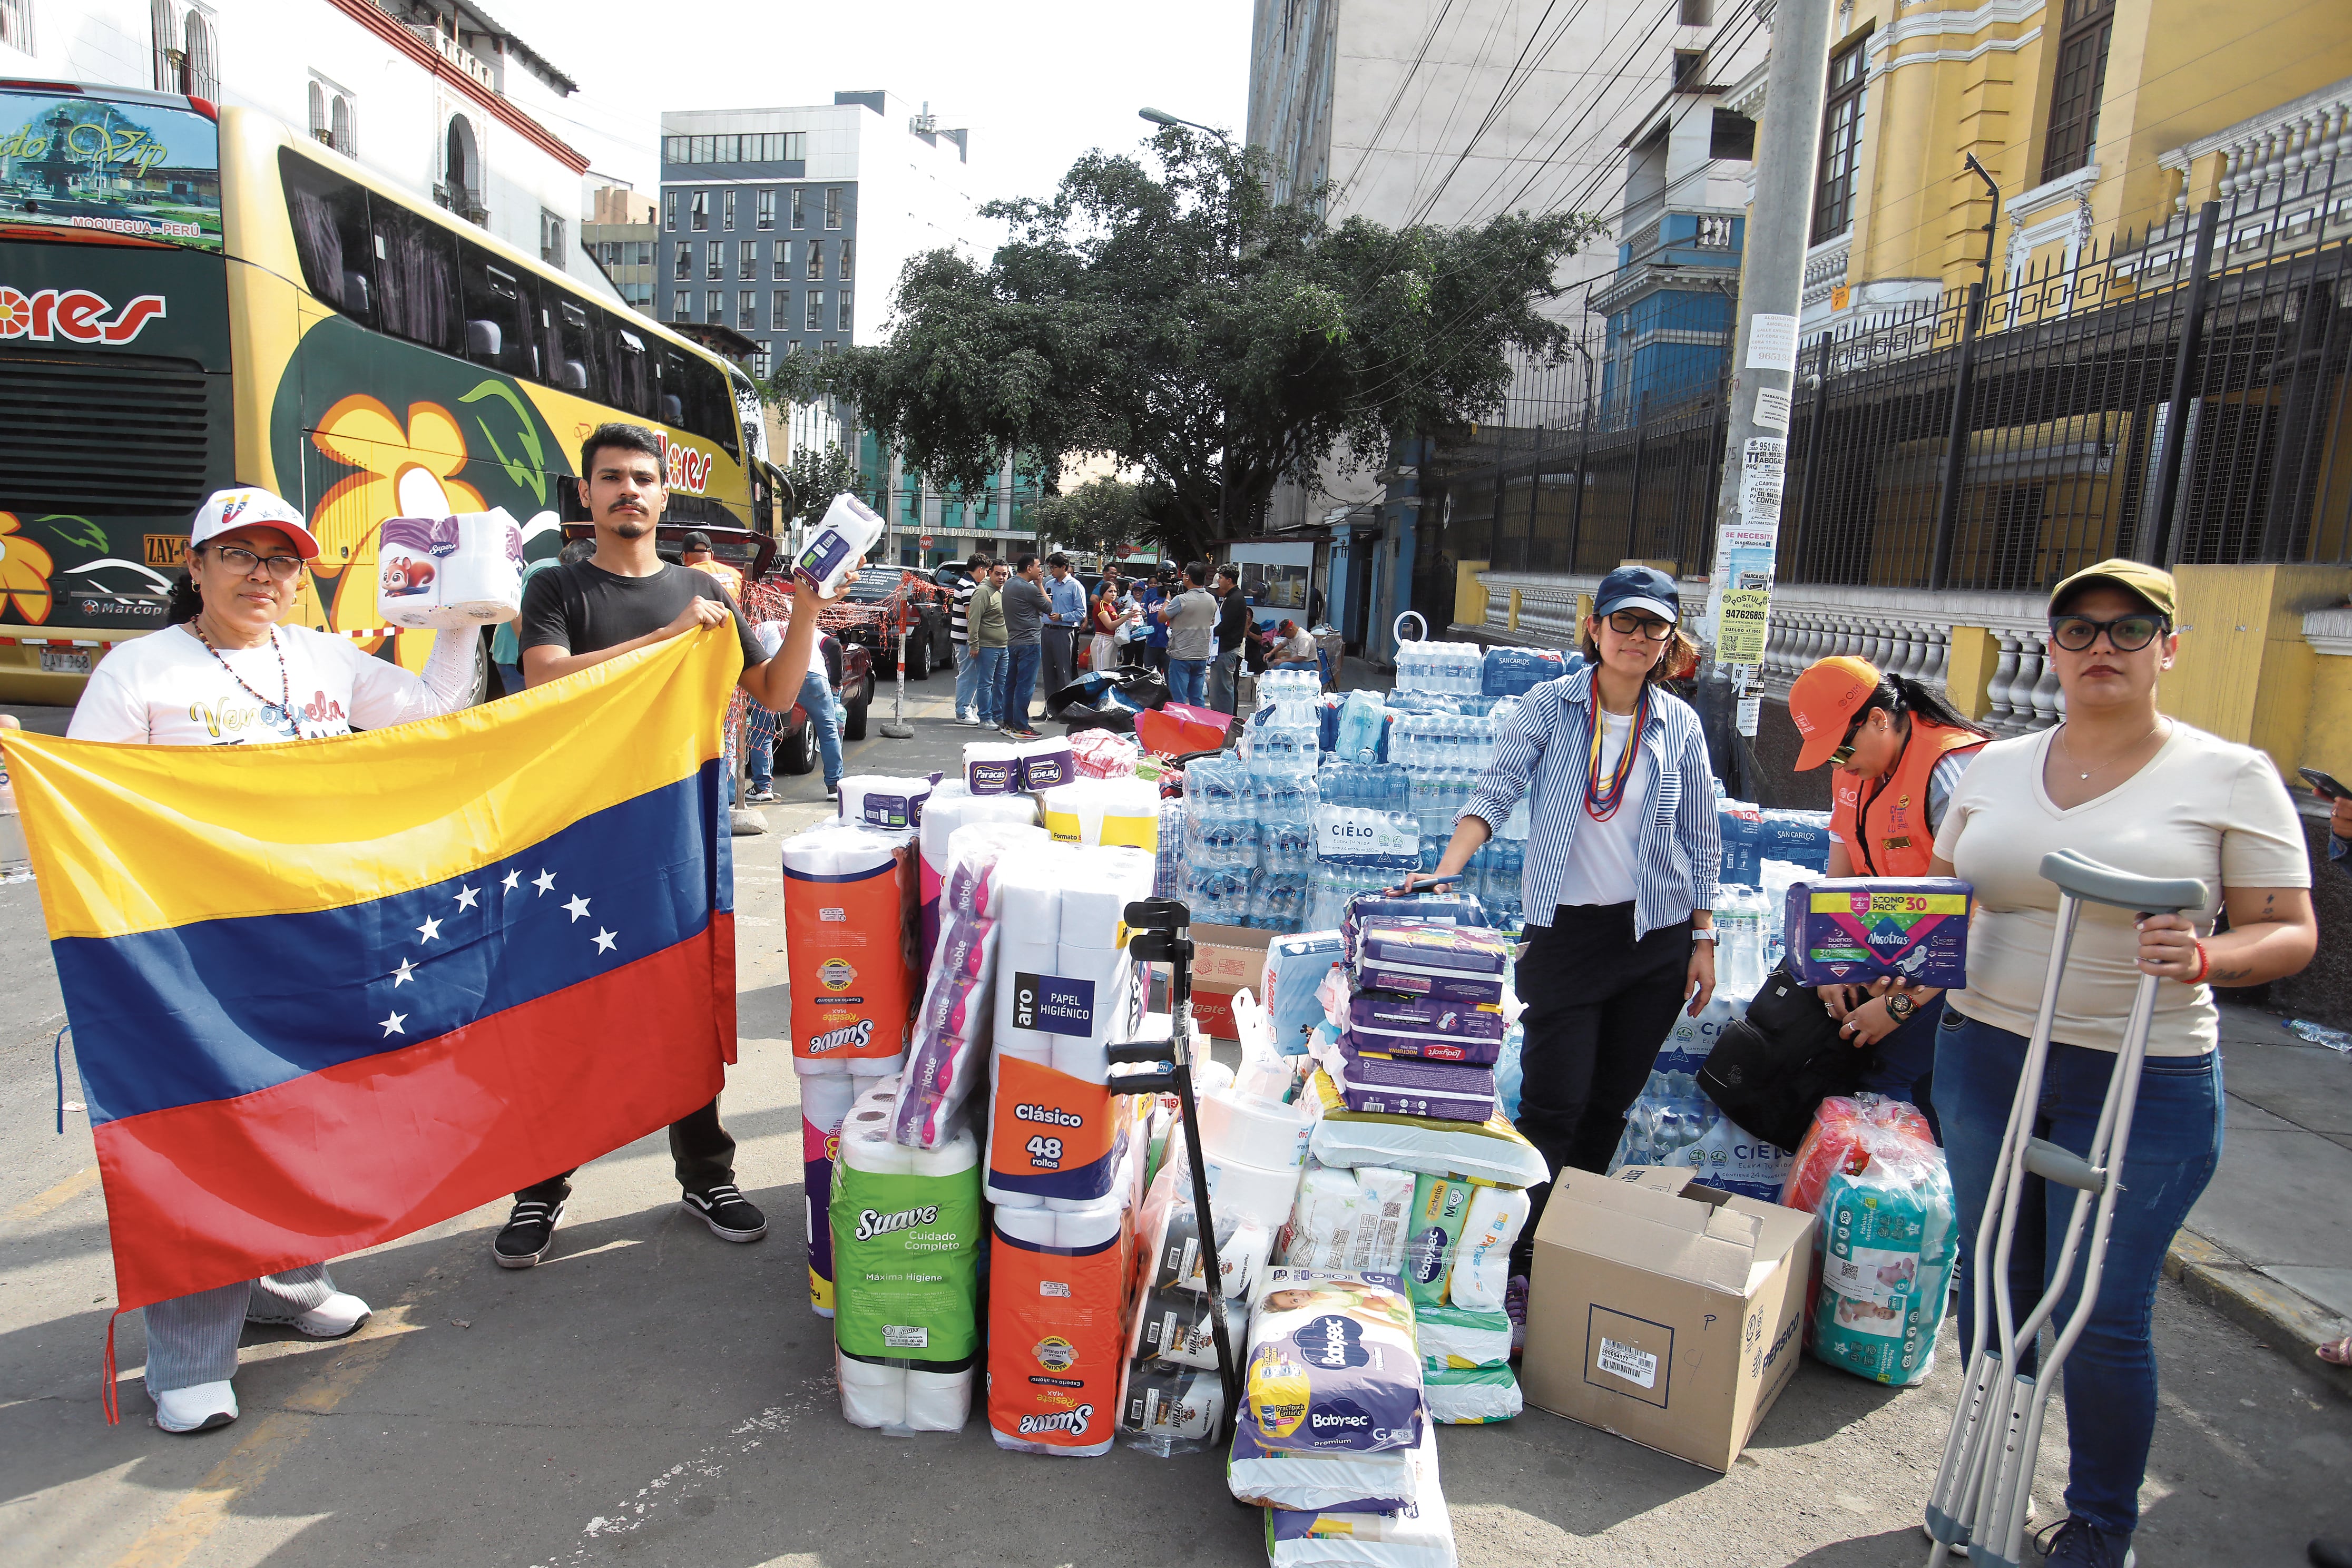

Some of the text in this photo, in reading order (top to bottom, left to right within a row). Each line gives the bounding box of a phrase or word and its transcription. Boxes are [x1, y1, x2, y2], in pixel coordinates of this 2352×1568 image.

[0, 124, 47, 158] do
[72, 217, 200, 237] MOQUEGUA PERÚ
[1759, 442, 1771, 452] 951
[1772, 443, 1780, 452] 661
[654, 429, 712, 494] lores
[901, 525, 992, 538] HOTEL EL DORADO
[1737, 532, 1773, 541] NECESITA
[429, 544, 456, 555] Super
[1730, 595, 1763, 608] POSTULA
[1726, 609, 1765, 620] 947626853
[43, 654, 89, 670] ZAY-968
[1846, 684, 1862, 700] OIM
[976, 770, 1005, 779] Paracas
[1031, 769, 1059, 779] Paracas
[1741, 811, 1759, 821] 10L
[1332, 820, 1373, 838] CIELO
[1791, 831, 1816, 841] CARLOS
[958, 879, 972, 910] Noble
[1905, 896, 1927, 911] 30
[1868, 930, 1908, 945] Nosotras
[1931, 935, 1938, 947] 8
[951, 940, 966, 972] Noble
[826, 982, 848, 991] MÁXIMA
[1051, 993, 1081, 1006] PAPEL
[1128, 975, 1141, 1037] aro
[936, 997, 950, 1029] Noble
[1018, 988, 1033, 1026] aro
[1040, 1004, 1090, 1020] HIGIÉNICO
[822, 1013, 859, 1023] Resiste
[808, 1019, 874, 1054] Suave
[1428, 1048, 1462, 1059] Ladysoft
[922, 1057, 937, 1087] Noble
[1015, 1104, 1082, 1128] Clásico
[1026, 1134, 1063, 1160] 48
[1031, 1157, 1059, 1169] rollos
[1428, 1184, 1444, 1216] Packetón
[1451, 1193, 1458, 1203] 68
[1444, 1205, 1456, 1218] M
[1841, 1211, 1849, 1222] XG
[854, 1204, 939, 1241] Suave
[1860, 1212, 1868, 1234] Pañales
[909, 1230, 956, 1241] Cuidado
[904, 1241, 960, 1252] Completo
[1416, 1229, 1439, 1280] Babysec
[866, 1272, 943, 1283] Máxima Higiene
[1239, 1264, 1249, 1288] Higiénico
[1438, 1266, 1446, 1283] Talla
[1703, 1314, 1717, 1331] P
[1912, 1312, 1918, 1322] RN
[899, 1327, 919, 1335] Suave
[1043, 1337, 1066, 1345] RESISTENCIA
[1188, 1324, 1201, 1356] Orion
[1321, 1317, 1349, 1366] Babysec
[1761, 1311, 1800, 1375] PEPSICO
[1602, 1348, 1629, 1361] 300054177
[1043, 1360, 1067, 1371] MÁXIMA
[1036, 1394, 1077, 1408] Resiste
[1276, 1404, 1305, 1412] Practipack
[1017, 1403, 1094, 1436] Suave
[1171, 1400, 1183, 1428] Orion
[1311, 1414, 1367, 1428] Babysec
[1372, 1428, 1386, 1441] G
[1314, 1438, 1352, 1447] Premium
